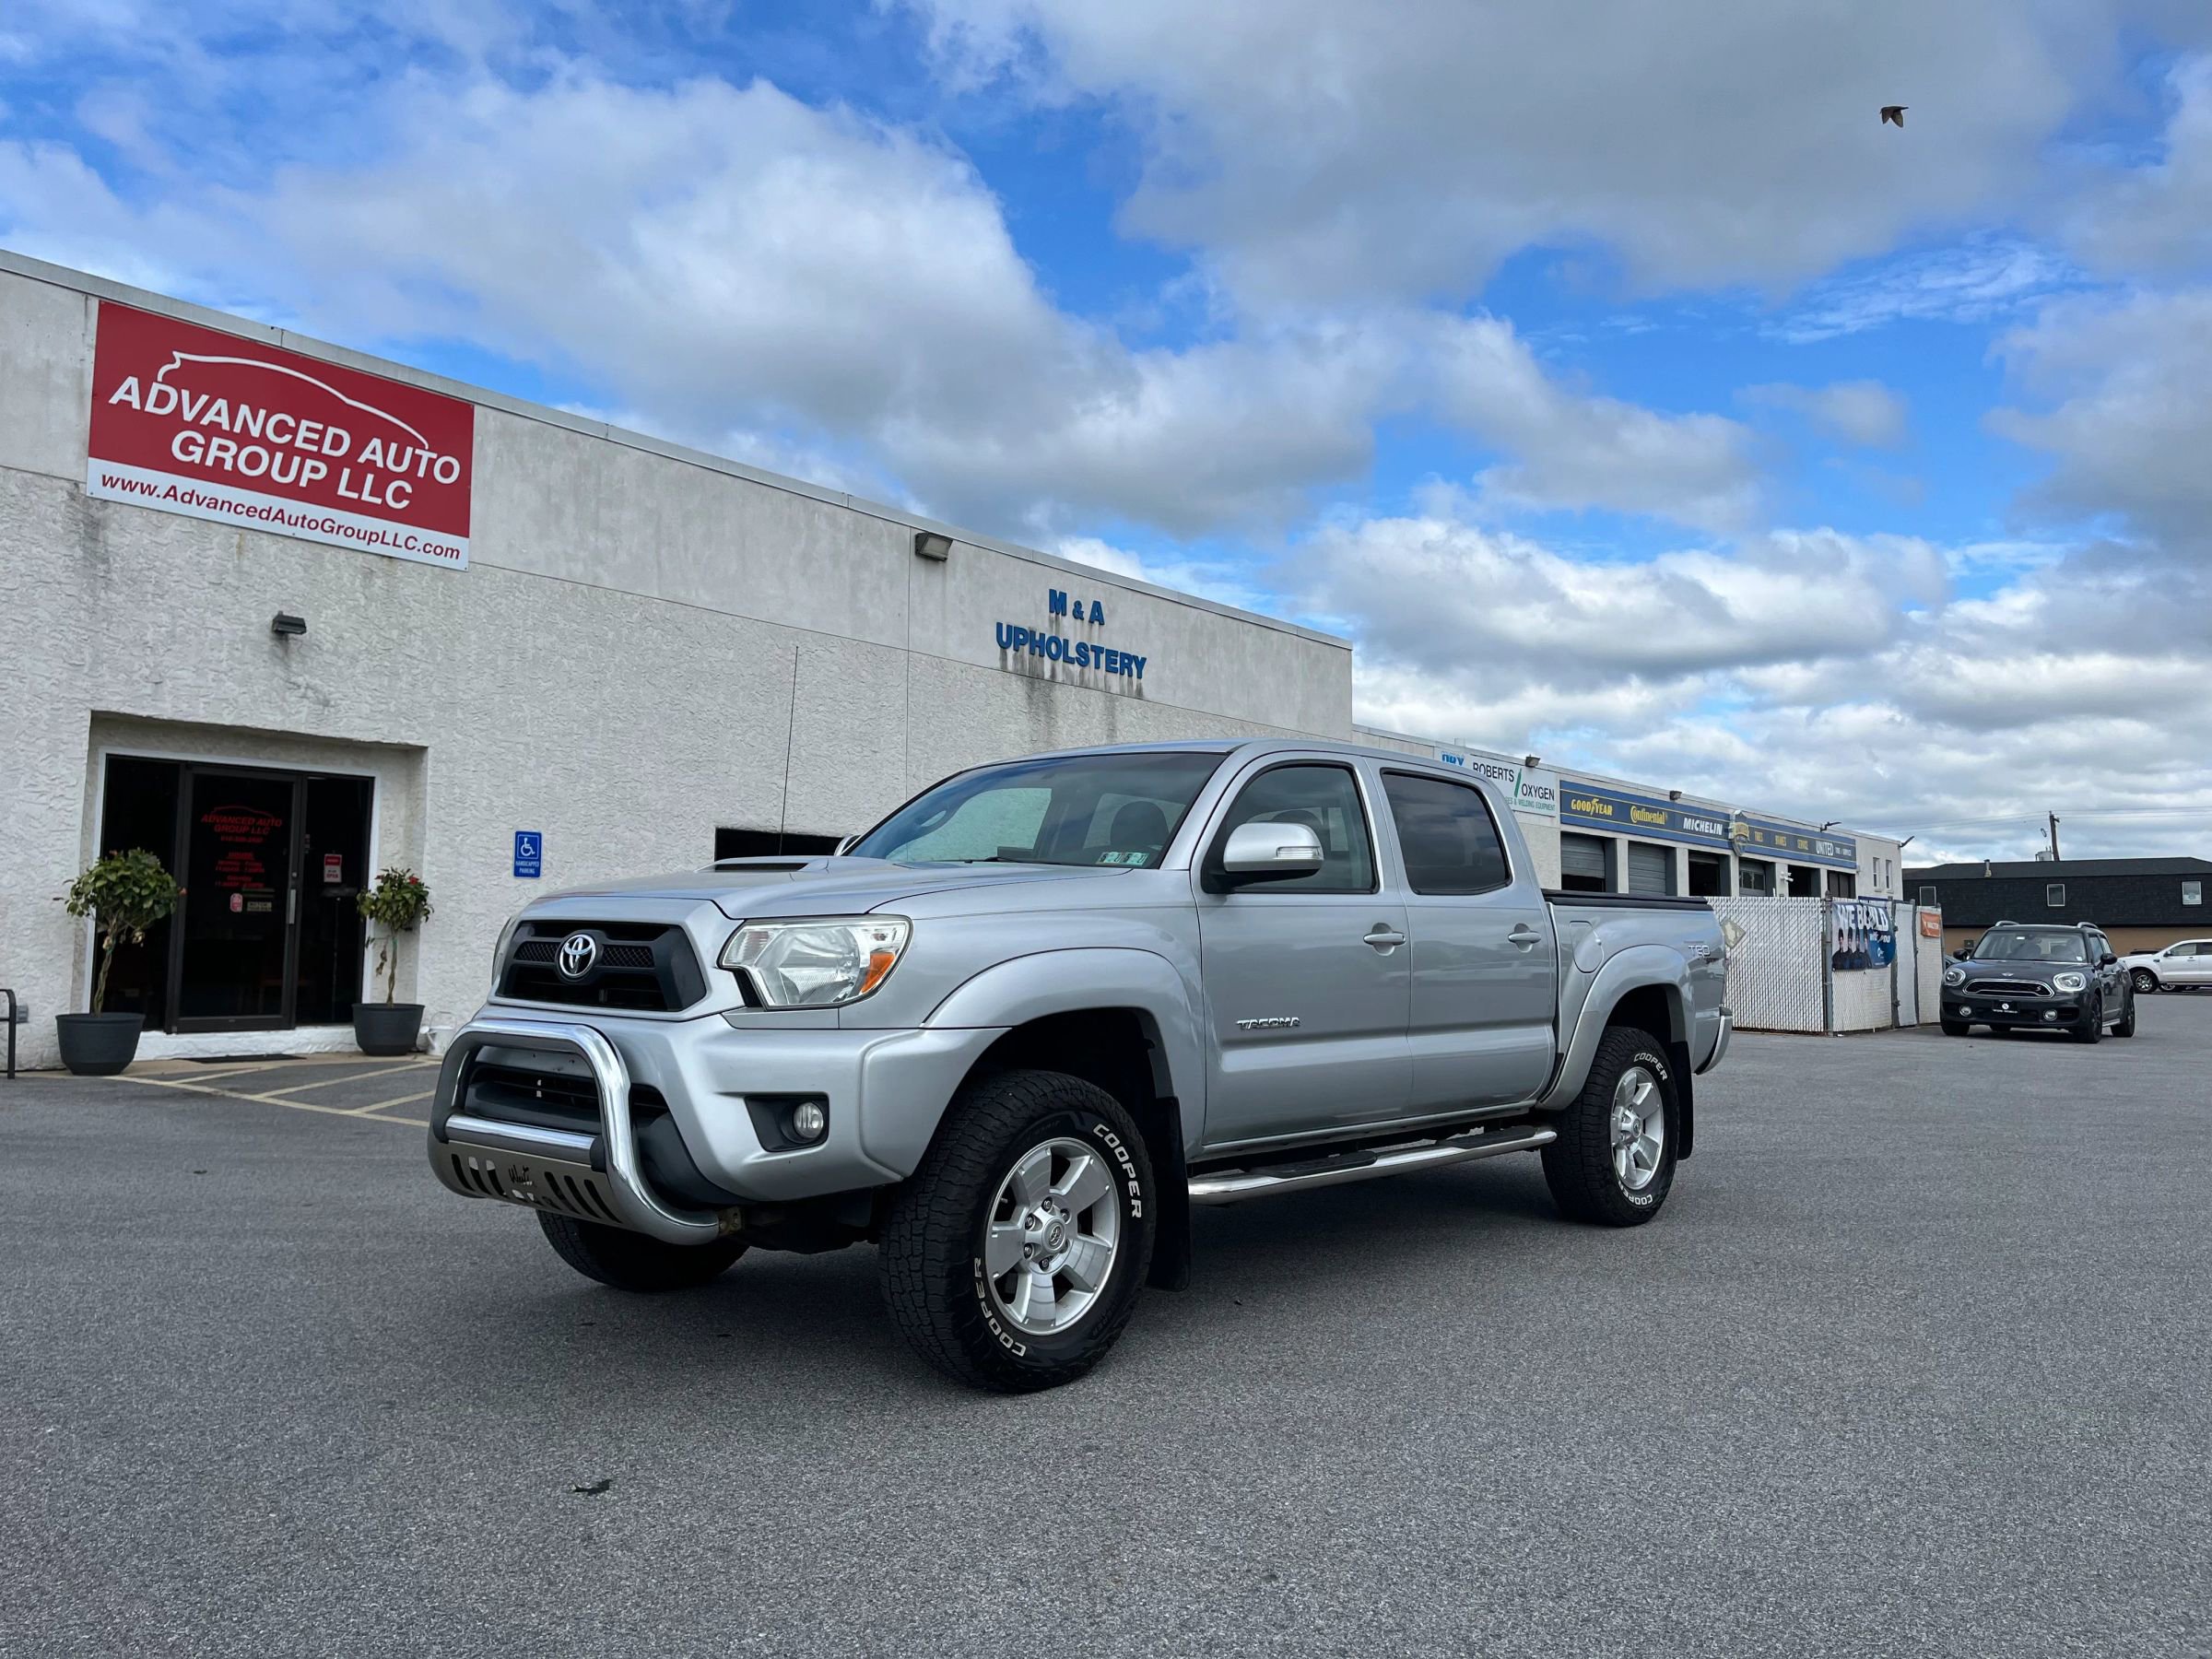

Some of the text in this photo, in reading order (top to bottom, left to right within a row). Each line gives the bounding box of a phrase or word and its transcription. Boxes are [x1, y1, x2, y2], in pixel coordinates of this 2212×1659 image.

[108, 376, 461, 485] ADVANCED AUTO
[171, 429, 413, 510] GROUP LLC
[100, 473, 461, 560] www.AdvancedAutoGroupLLC.com
[1048, 589, 1105, 626] M & A
[995, 622, 1147, 679] UPHOLSTERY
[1473, 762, 1514, 782] ROBERTS
[1521, 783, 1555, 801] OXYGEN
[201, 814, 282, 827] ADVANCED AUTO
[1571, 797, 1613, 817] GOODYEAR
[1630, 806, 1665, 825] Continental
[1683, 818, 1723, 835] MICHELIN
[1816, 840, 1834, 855] UNITED
[1633, 1052, 1668, 1081] COOPER
[1093, 1124, 1142, 1218] COOPER
[1618, 1180, 1653, 1206] COOPER
[973, 1257, 1027, 1357] COOPER
